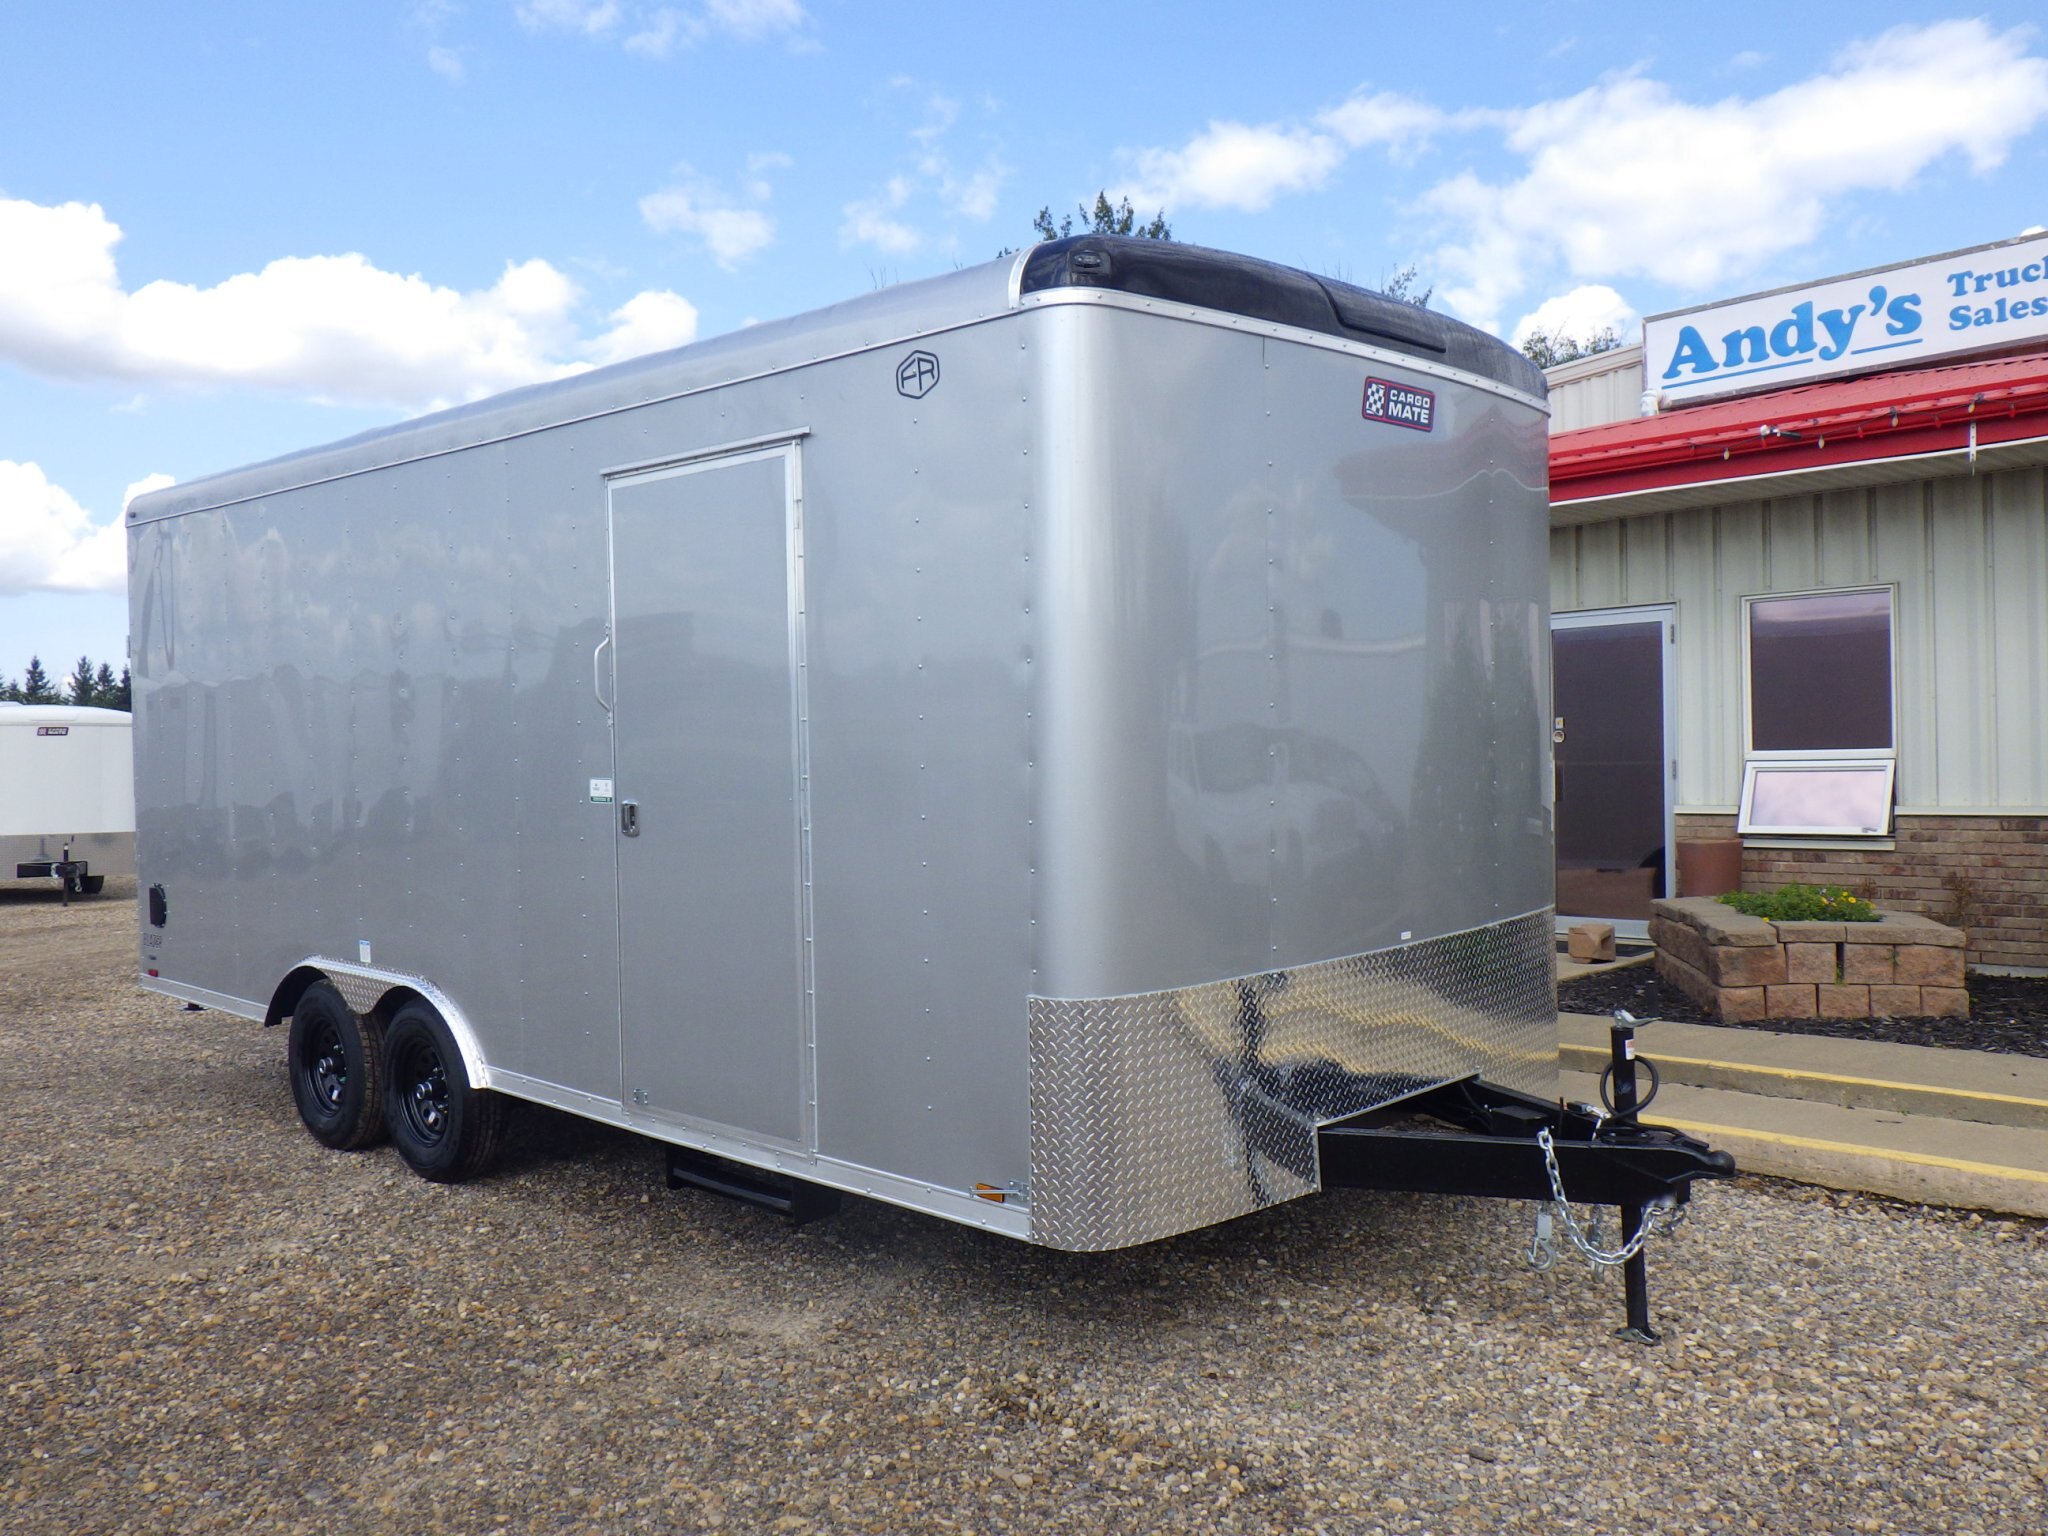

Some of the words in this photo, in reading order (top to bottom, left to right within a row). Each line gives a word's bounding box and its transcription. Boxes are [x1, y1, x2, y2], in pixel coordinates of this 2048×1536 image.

[1947, 255, 2048, 296] Truc
[1949, 297, 2048, 331] Sales
[1661, 285, 1922, 380] Andy's
[1388, 401, 1430, 423] MATE
[1390, 389, 1430, 408] CARGO
